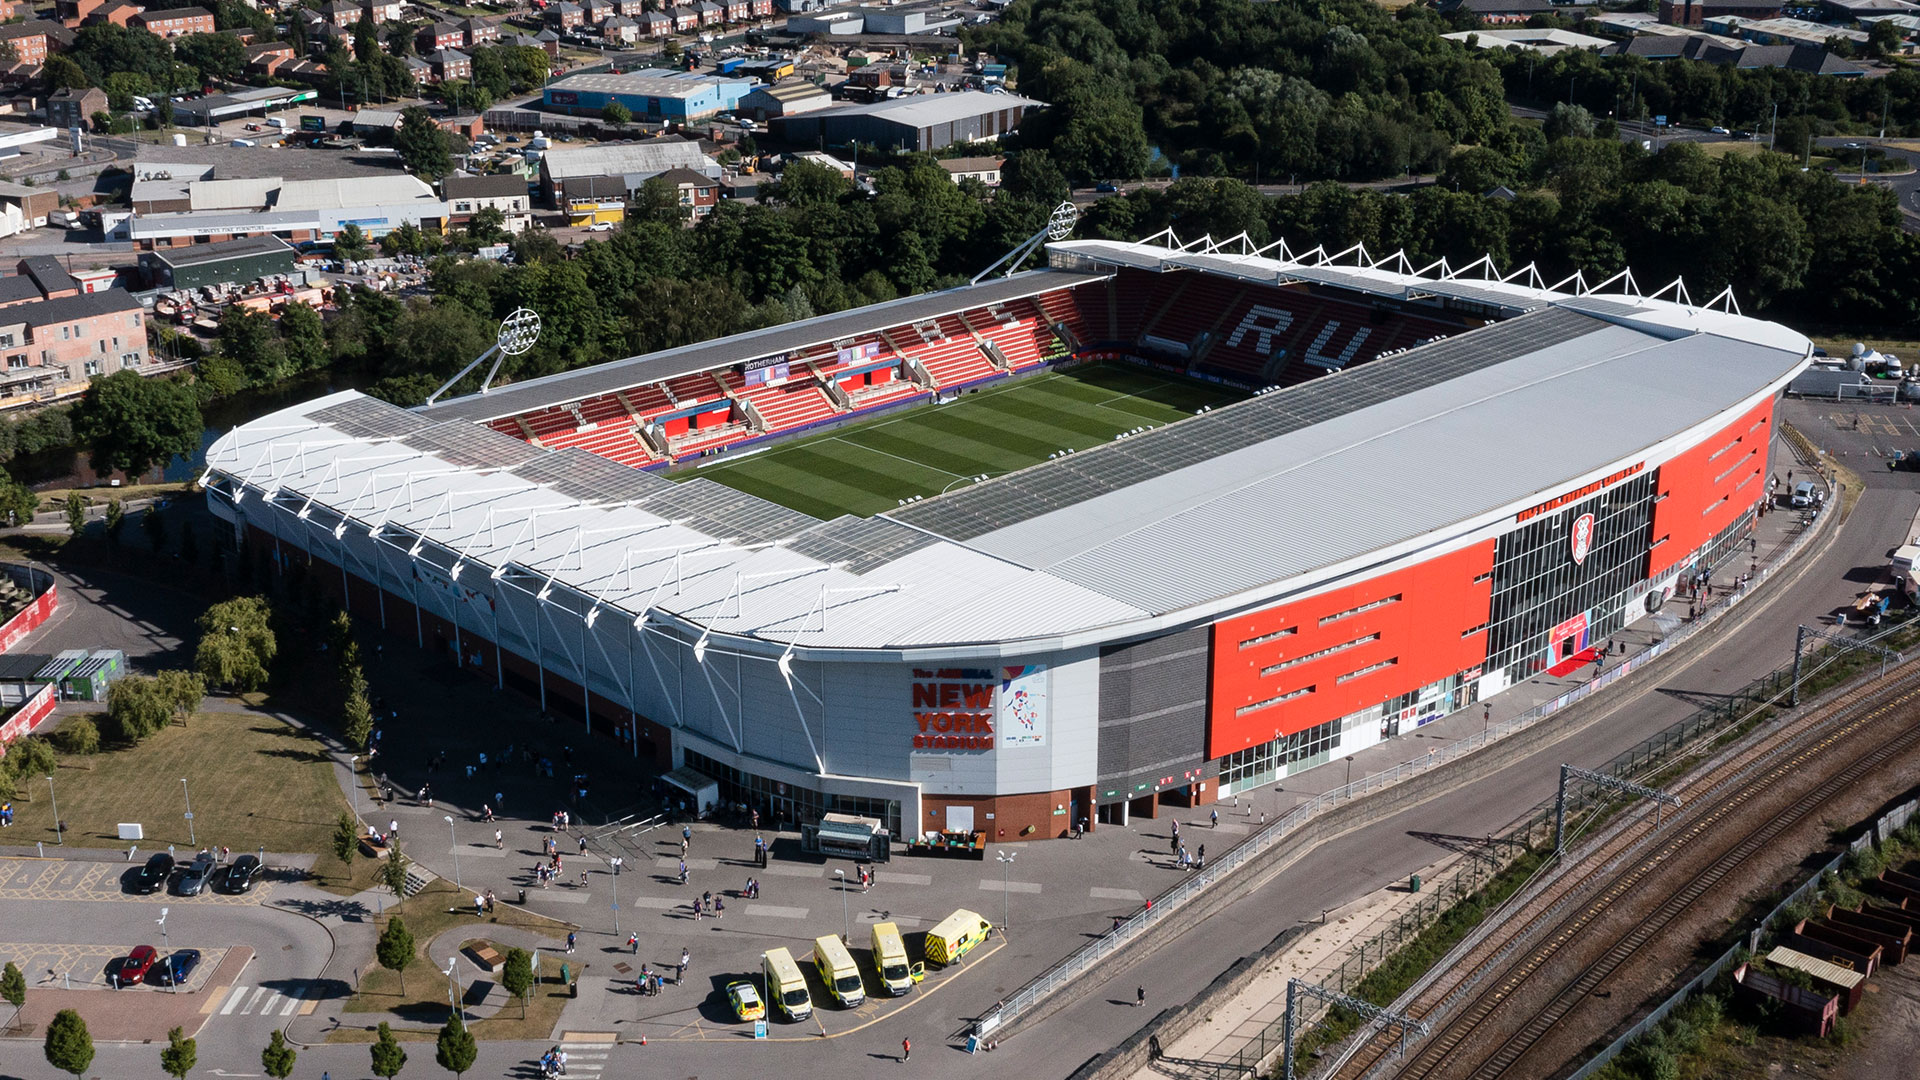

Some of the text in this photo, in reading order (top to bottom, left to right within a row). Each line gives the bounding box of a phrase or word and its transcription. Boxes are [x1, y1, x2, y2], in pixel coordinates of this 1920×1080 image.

[912, 668, 934, 679] The
[912, 683, 995, 709] NEW
[913, 711, 995, 734] YORK
[912, 735, 994, 750] STADIUM
